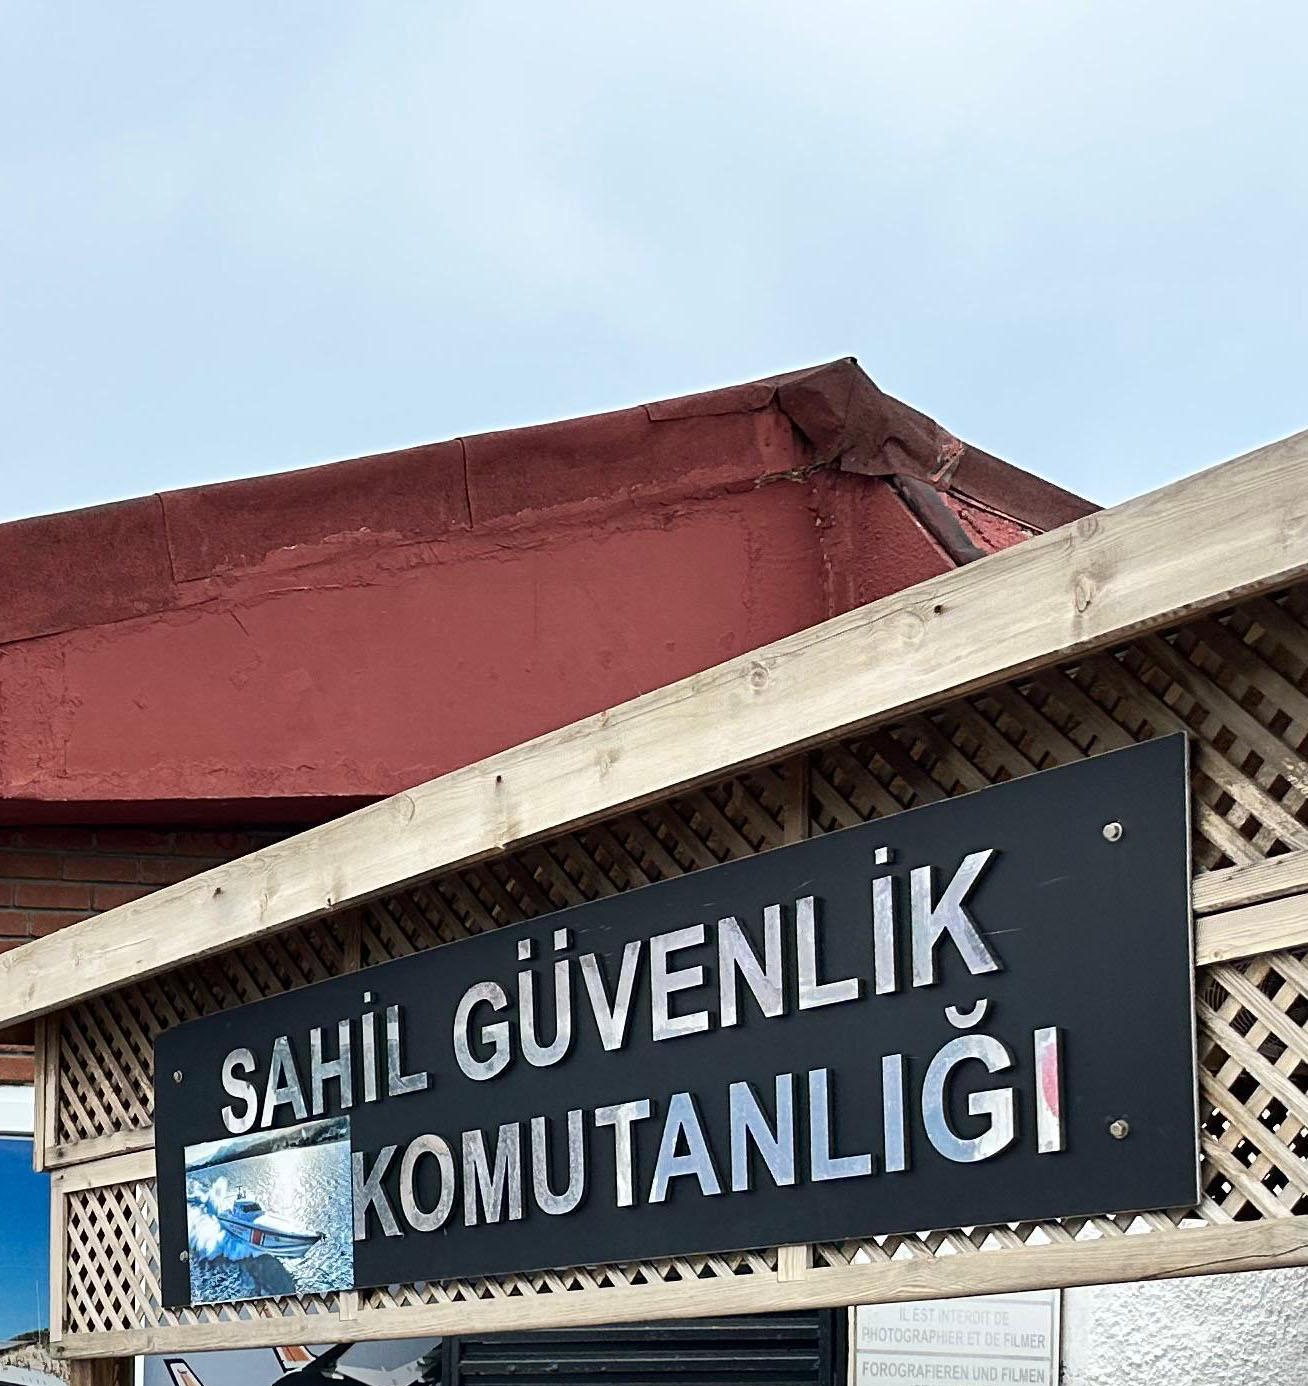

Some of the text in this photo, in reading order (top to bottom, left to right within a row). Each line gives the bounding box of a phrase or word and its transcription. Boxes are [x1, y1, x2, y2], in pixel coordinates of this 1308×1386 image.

[221, 847, 1000, 1133] SAHİL GÜVENLİK
[352, 999, 1066, 1241] KOMUTANLIĞI
[912, 1307, 935, 1323] EST
[862, 1327, 963, 1345] PHOTOGRAPHIER
[967, 1331, 981, 1346] ET
[1003, 1333, 1045, 1349] FILMER
[972, 1367, 998, 1381] UND
[1001, 1367, 1045, 1383] FILMEN
